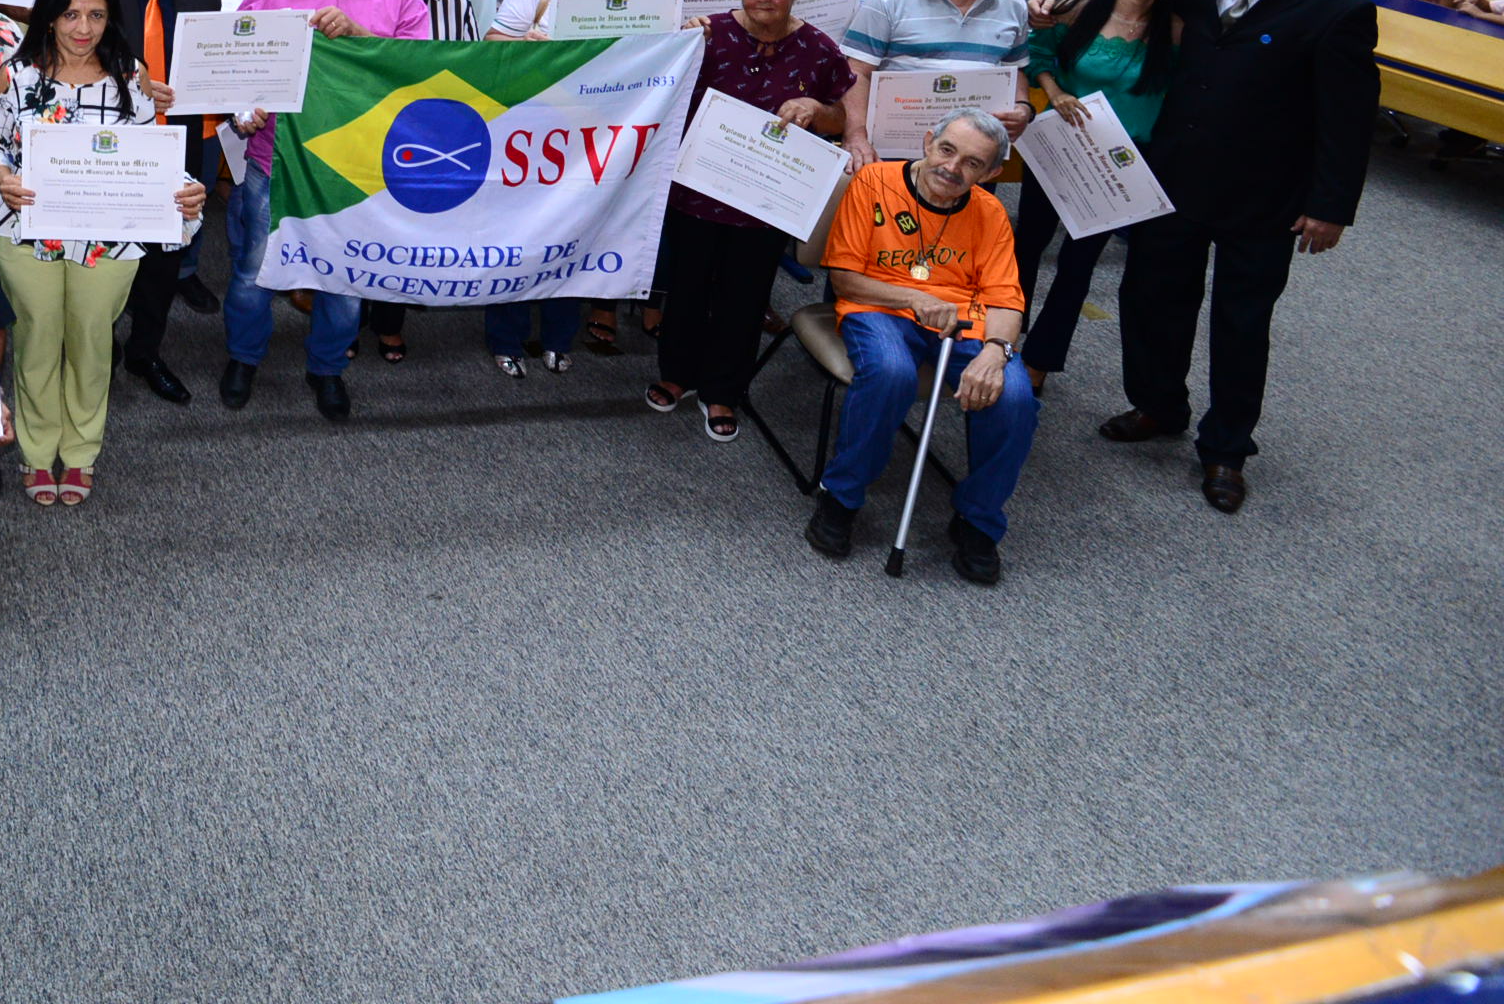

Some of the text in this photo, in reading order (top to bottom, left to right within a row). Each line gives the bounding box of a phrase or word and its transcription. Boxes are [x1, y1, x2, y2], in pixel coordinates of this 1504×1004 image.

[579, 76, 675, 95] Fundada em 1833
[50, 157, 80, 166] Diploma
[95, 158, 117, 166] Honra
[133, 160, 159, 168] Mérito
[344, 239, 579, 269] SOCIEDADE DE
[280, 242, 334, 276] SÃO
[344, 267, 480, 297] VICENTE
[489, 276, 529, 297] DE
